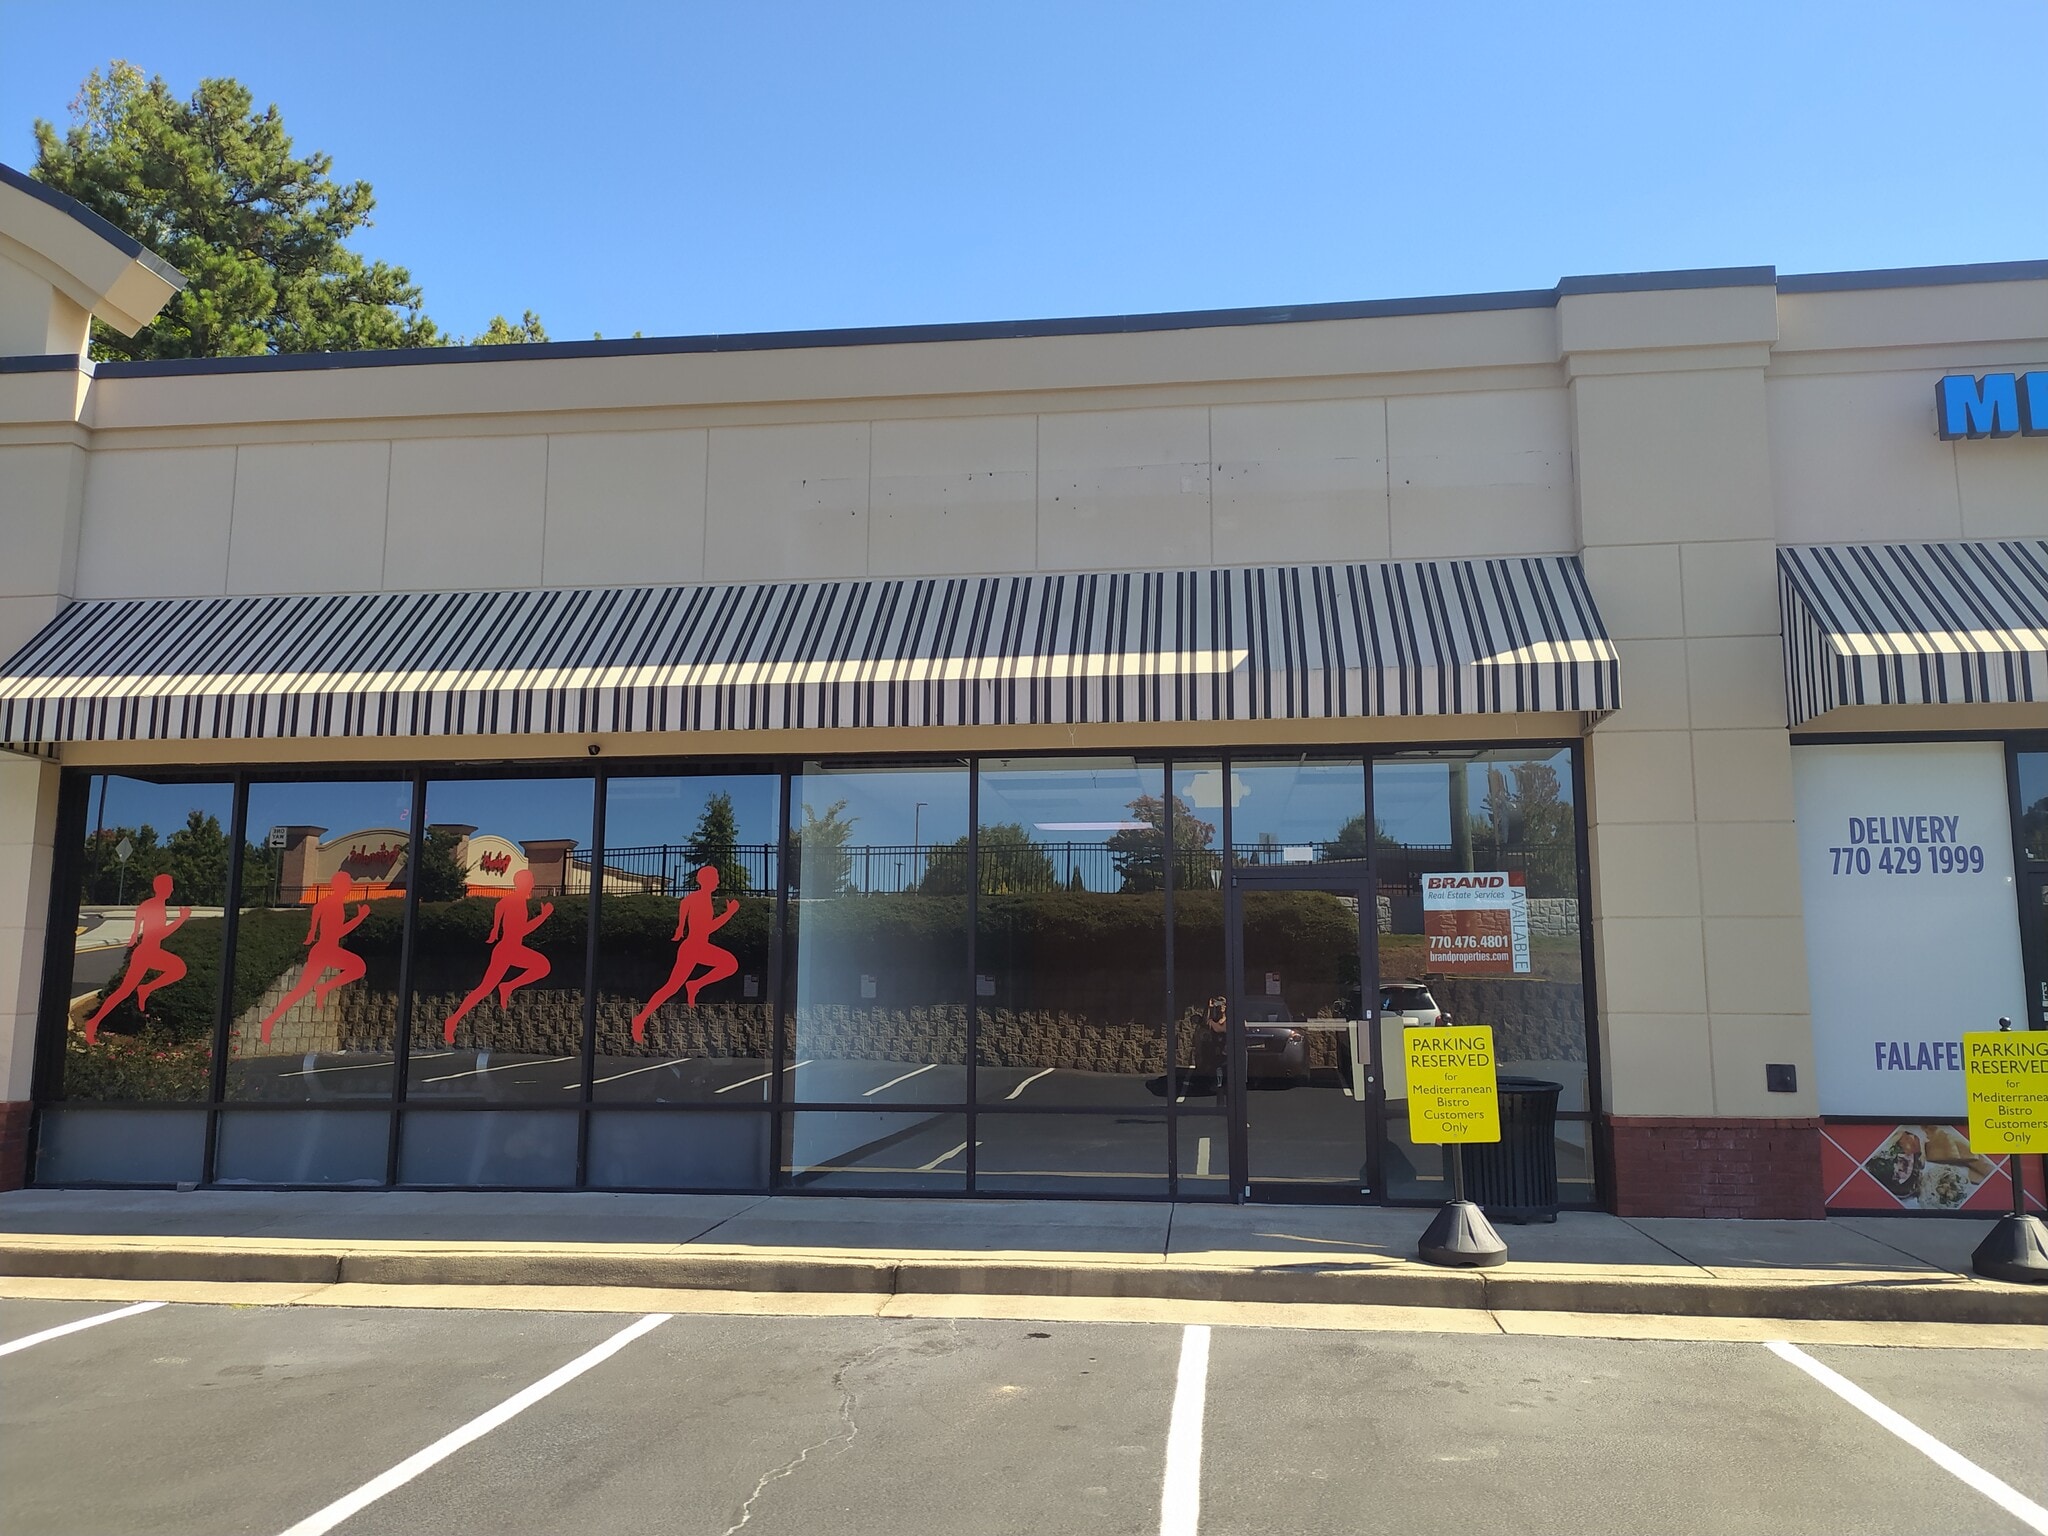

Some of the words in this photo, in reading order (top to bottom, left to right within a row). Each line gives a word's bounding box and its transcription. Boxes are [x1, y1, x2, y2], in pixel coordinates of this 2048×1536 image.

[1849, 816, 1959, 844] DELIVERY
[1829, 847, 1871, 875] 770
[1878, 847, 1921, 875] 429
[1928, 846, 1984, 874] 1999
[1428, 876, 1504, 889] BRAND
[1447, 891, 1471, 899] Estate
[1474, 890, 1505, 899] Services
[1511, 889, 1528, 969] AVAILABLE
[1430, 935, 1509, 949] 770.476.4801
[1430, 950, 1509, 964] brandproperties.com
[1412, 1037, 1485, 1052] PARKING
[1972, 1042, 2048, 1057] PARKING
[1411, 1053, 1489, 1068] RESERVED
[1875, 1041, 1965, 1071] FALAFE
[1444, 1072, 1458, 1081] for
[1412, 1084, 1492, 1095] Mediterranean
[2006, 1079, 2020, 1088] for
[1437, 1097, 1470, 1107] Bistro
[1972, 1091, 2048, 1102] Mediterranea
[1424, 1109, 1485, 1120] Customers
[1998, 1105, 2033, 1116] Bistro
[1441, 1122, 1468, 1135] Only
[1984, 1118, 2048, 1129] Customers
[2003, 1131, 2031, 1145] Only
